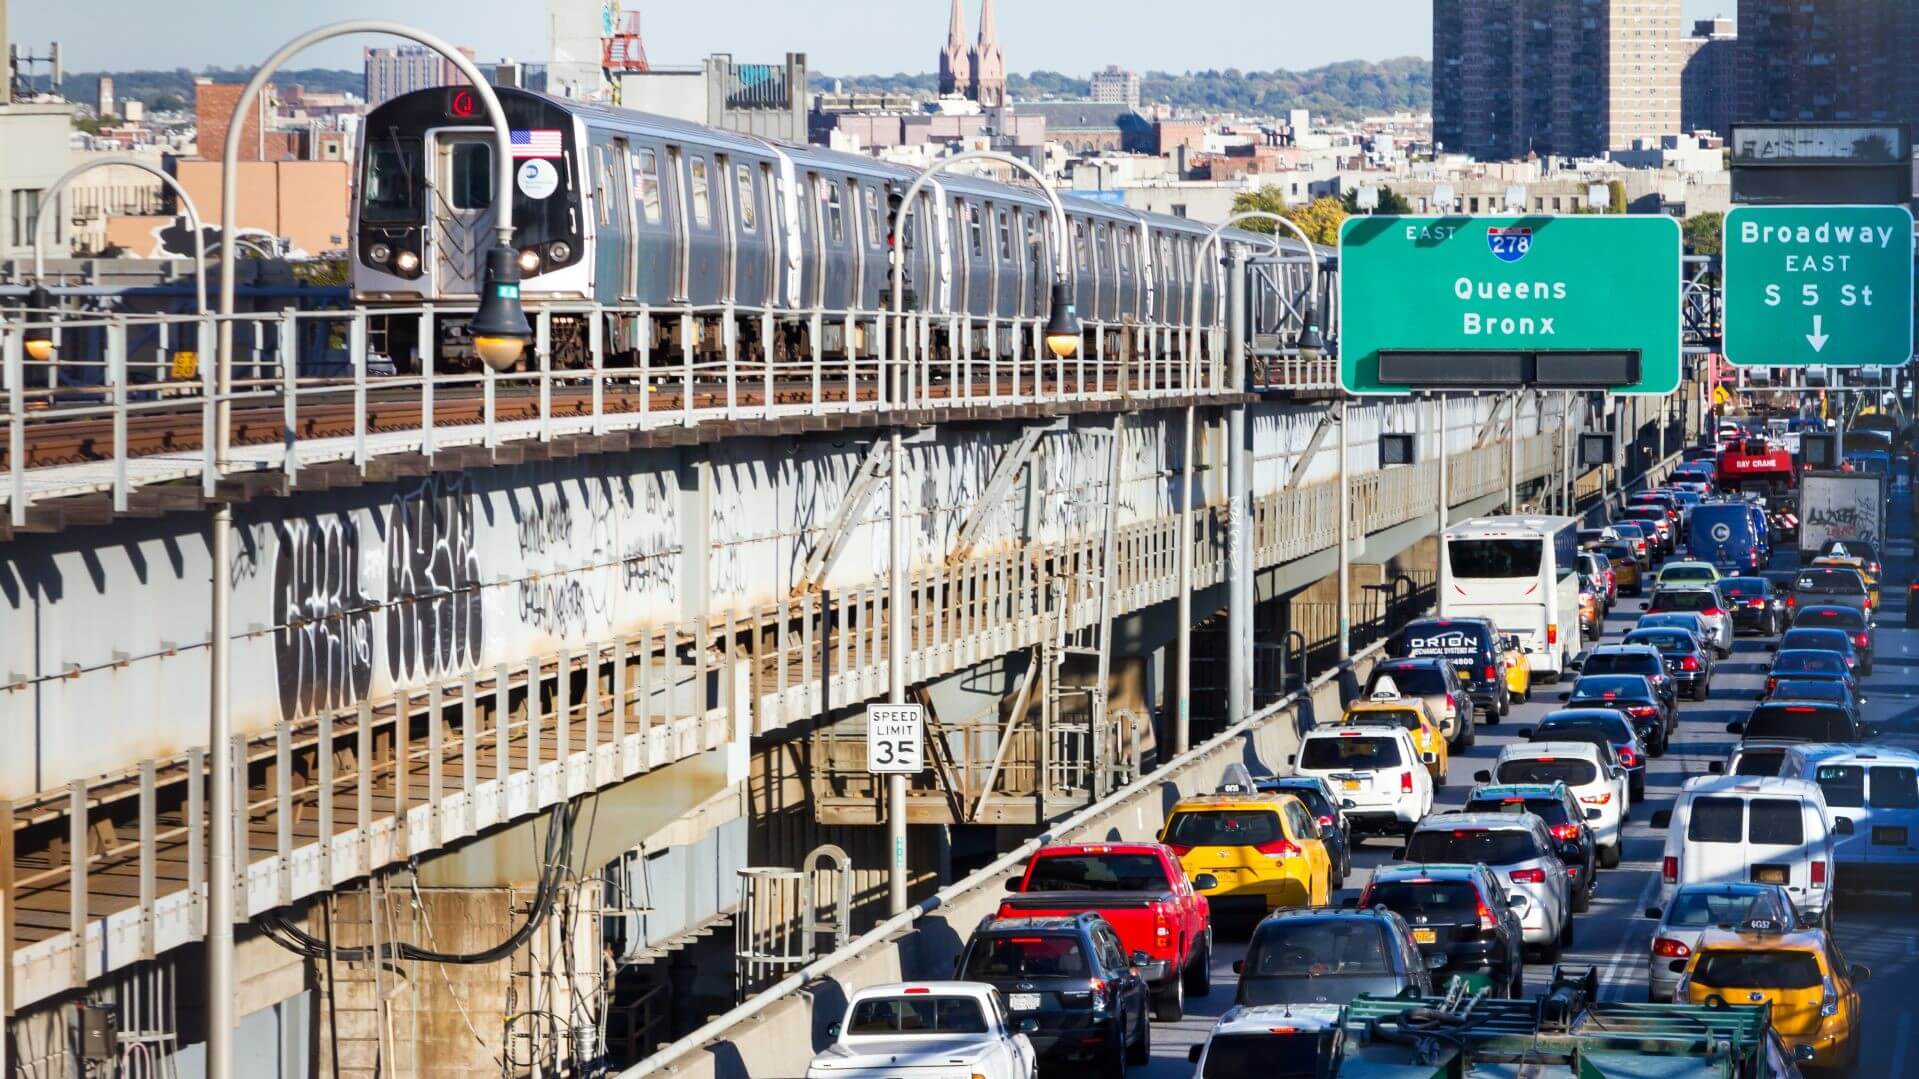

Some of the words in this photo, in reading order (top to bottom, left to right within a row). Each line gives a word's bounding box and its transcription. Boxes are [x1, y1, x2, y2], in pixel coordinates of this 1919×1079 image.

[1406, 226, 1456, 240] EAST
[1741, 221, 1893, 248] Broadway
[1493, 236, 1529, 253] 278
[1786, 255, 1850, 272] EAST
[1454, 277, 1567, 300] Queens
[1764, 284, 1781, 306] S
[1802, 284, 1819, 306] 5
[1840, 284, 1873, 306] St
[1463, 312, 1555, 335] Bronx
[1752, 459, 1777, 468] CRANE
[1411, 637, 1477, 647] ORION
[873, 712, 918, 721] SPEED
[877, 726, 912, 736] LIMIT
[876, 740, 914, 764] 35
